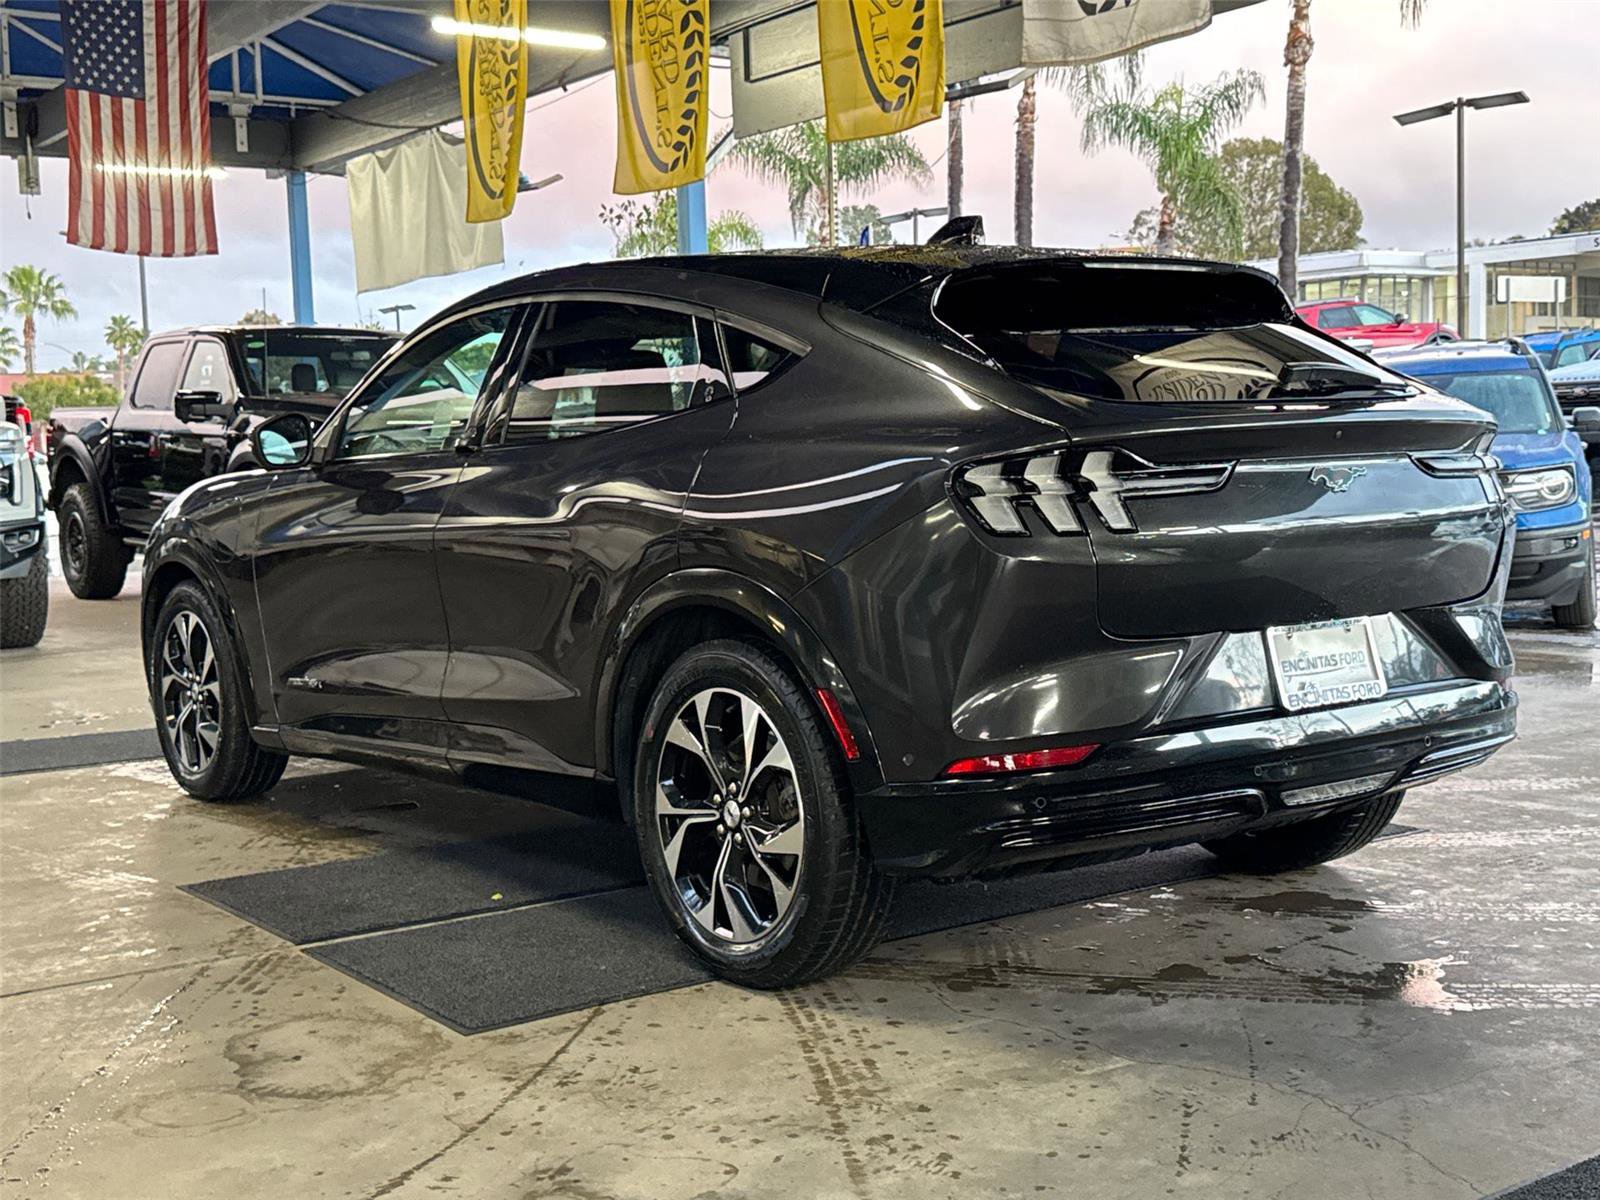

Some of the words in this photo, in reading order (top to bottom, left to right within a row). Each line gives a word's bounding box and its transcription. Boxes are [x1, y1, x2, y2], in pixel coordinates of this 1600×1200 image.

[1281, 653, 1338, 674] ENCINITAS
[1338, 650, 1366, 666] FORD
[1287, 685, 1351, 708] ENCINITAS
[1351, 682, 1382, 699] FORD
